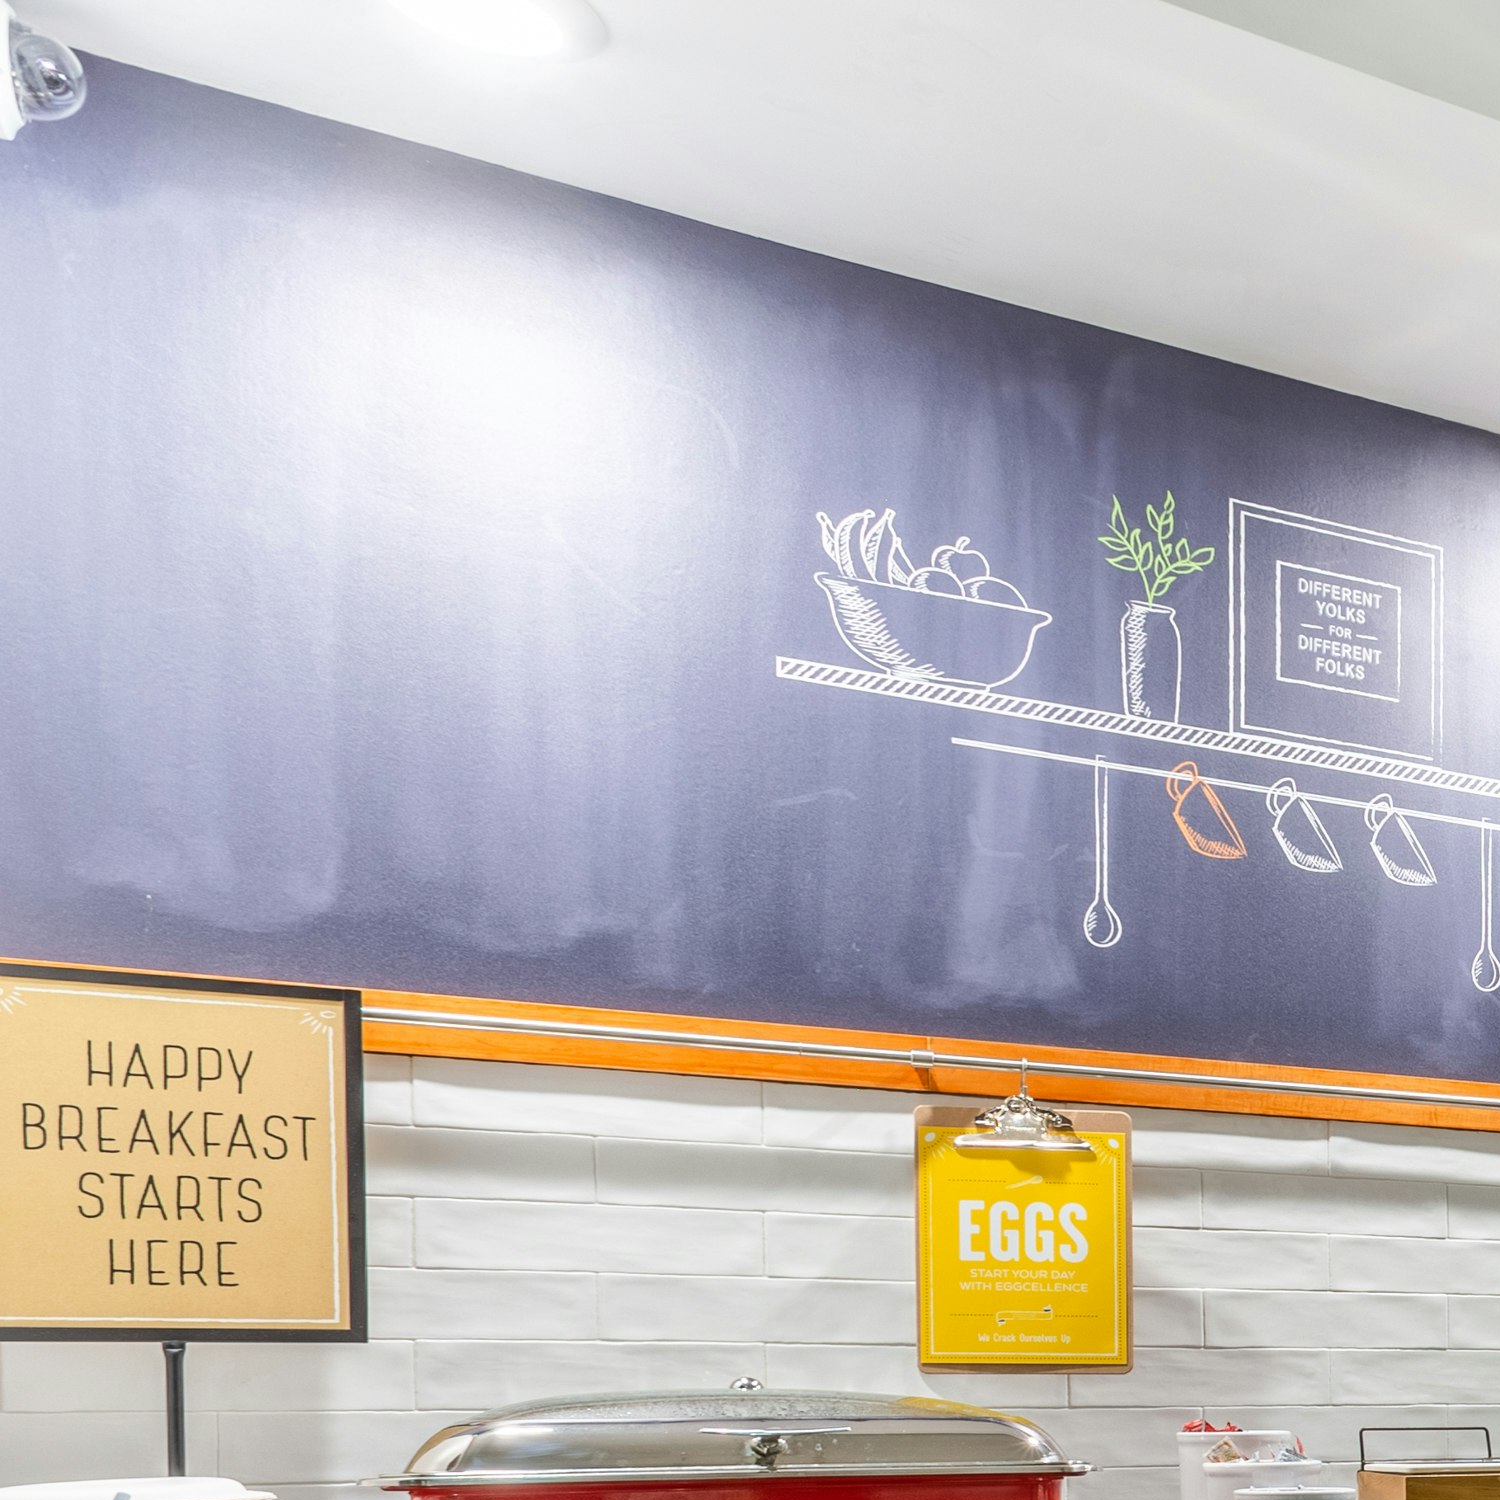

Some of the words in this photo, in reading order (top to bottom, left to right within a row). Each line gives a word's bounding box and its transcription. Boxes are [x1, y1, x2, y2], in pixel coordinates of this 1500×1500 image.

[1298, 577, 1382, 609] DIFFERENT
[1316, 600, 1366, 625] YOLKS
[1329, 625, 1352, 640] FOR
[1298, 634, 1382, 665] DIFFERENT
[1316, 657, 1366, 681] FOLKS
[86, 1039, 254, 1094] HAPPY
[21, 1102, 317, 1161] BREAKFAST
[77, 1172, 263, 1223] STARTS
[958, 1200, 1089, 1263] EGGS
[108, 1238, 241, 1287] HERE
[970, 1268, 1008, 1279] START
[1013, 1269, 1047, 1280] YOUR
[1050, 1270, 1076, 1280] DAY
[959, 1282, 992, 1291] WITH
[995, 1282, 1089, 1293] EGGCELLENCE
[978, 1333, 991, 1343] We
[993, 1333, 1016, 1343] Crack
[1019, 1333, 1057, 1343] Ourselves
[1061, 1334, 1071, 1345] Up
